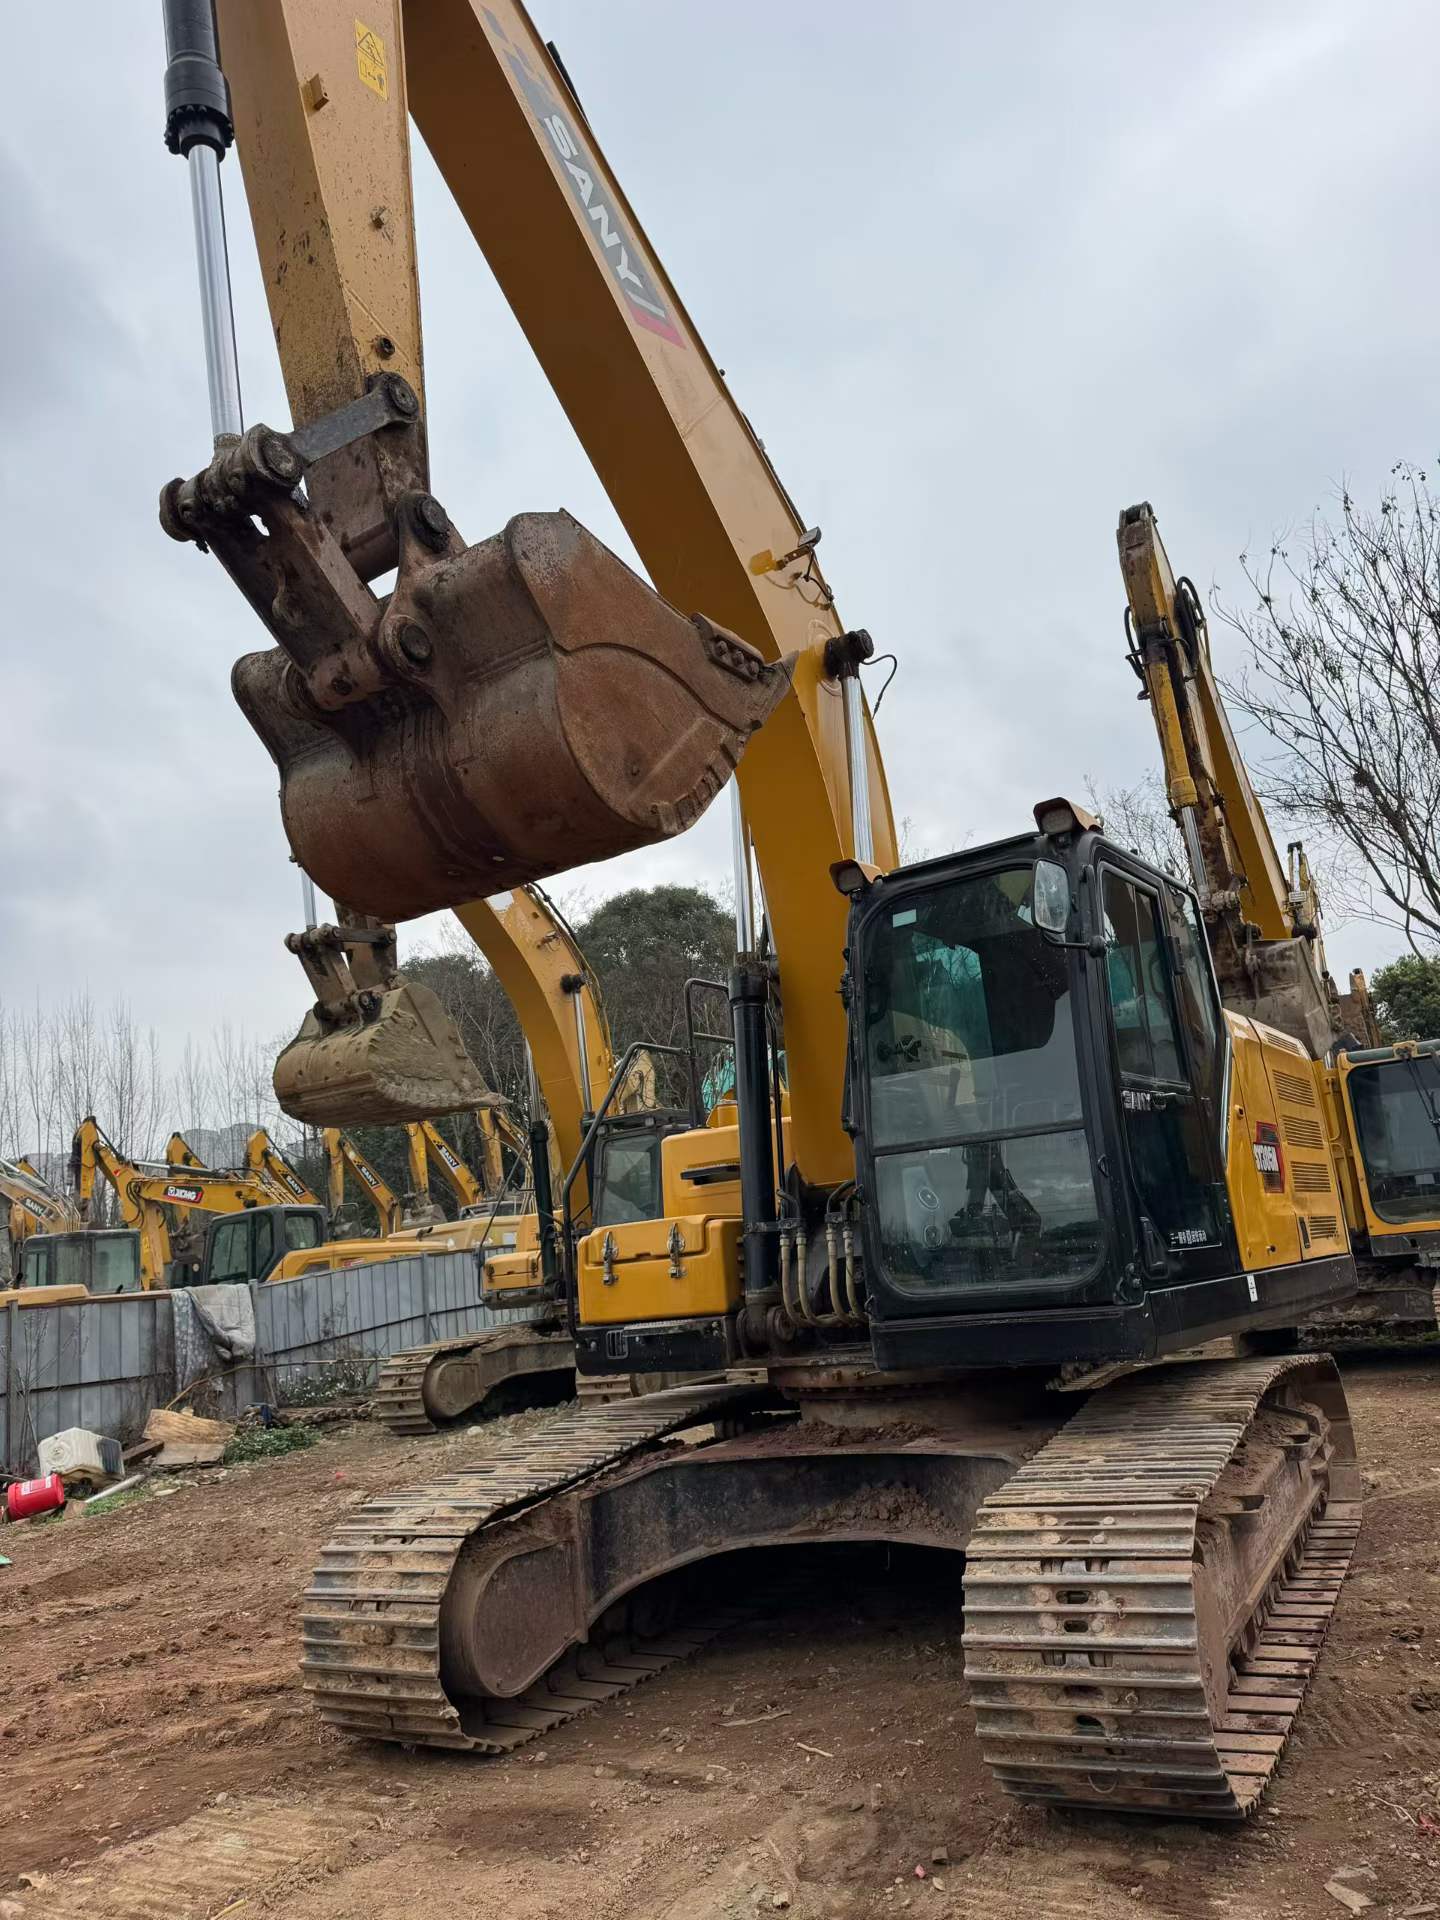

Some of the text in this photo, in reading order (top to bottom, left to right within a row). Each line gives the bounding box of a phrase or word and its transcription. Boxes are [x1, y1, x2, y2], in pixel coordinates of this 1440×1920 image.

[543, 114, 644, 289] SANY
[442, 1148, 458, 1167] SANY
[287, 1176, 303, 1194] SANY
[361, 1166, 378, 1186] SANY
